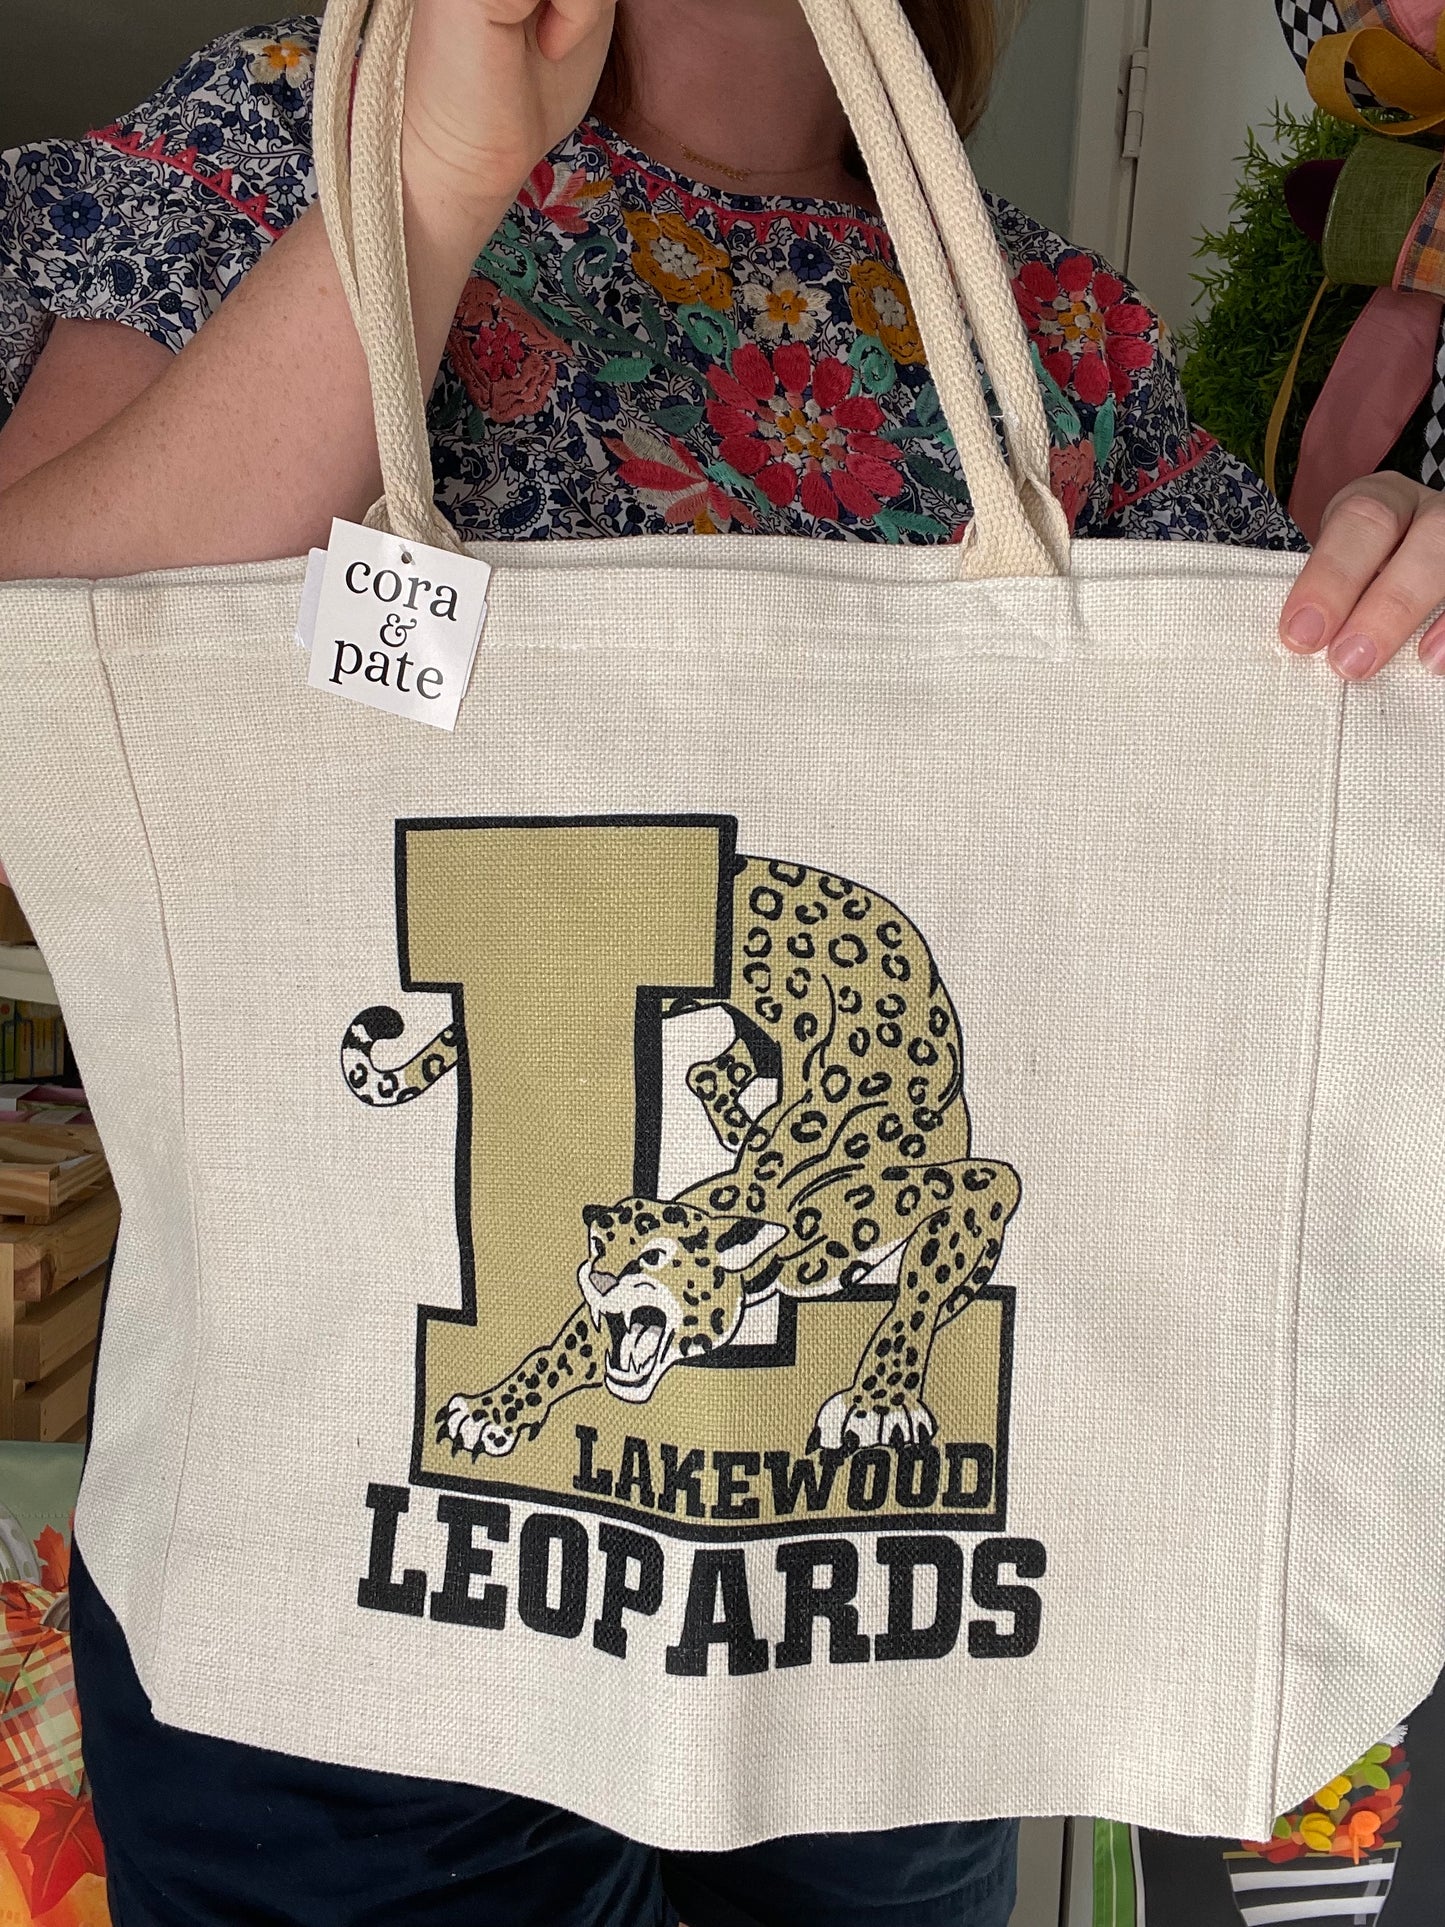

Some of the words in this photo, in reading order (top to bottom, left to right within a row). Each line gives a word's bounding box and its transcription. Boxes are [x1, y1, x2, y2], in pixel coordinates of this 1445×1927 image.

[345, 561, 458, 621] cora
[379, 613, 417, 648] &
[328, 640, 444, 700] pate
[573, 1424, 996, 1519] LAKEWOOD
[357, 1483, 1047, 1677] LEOPARDS
